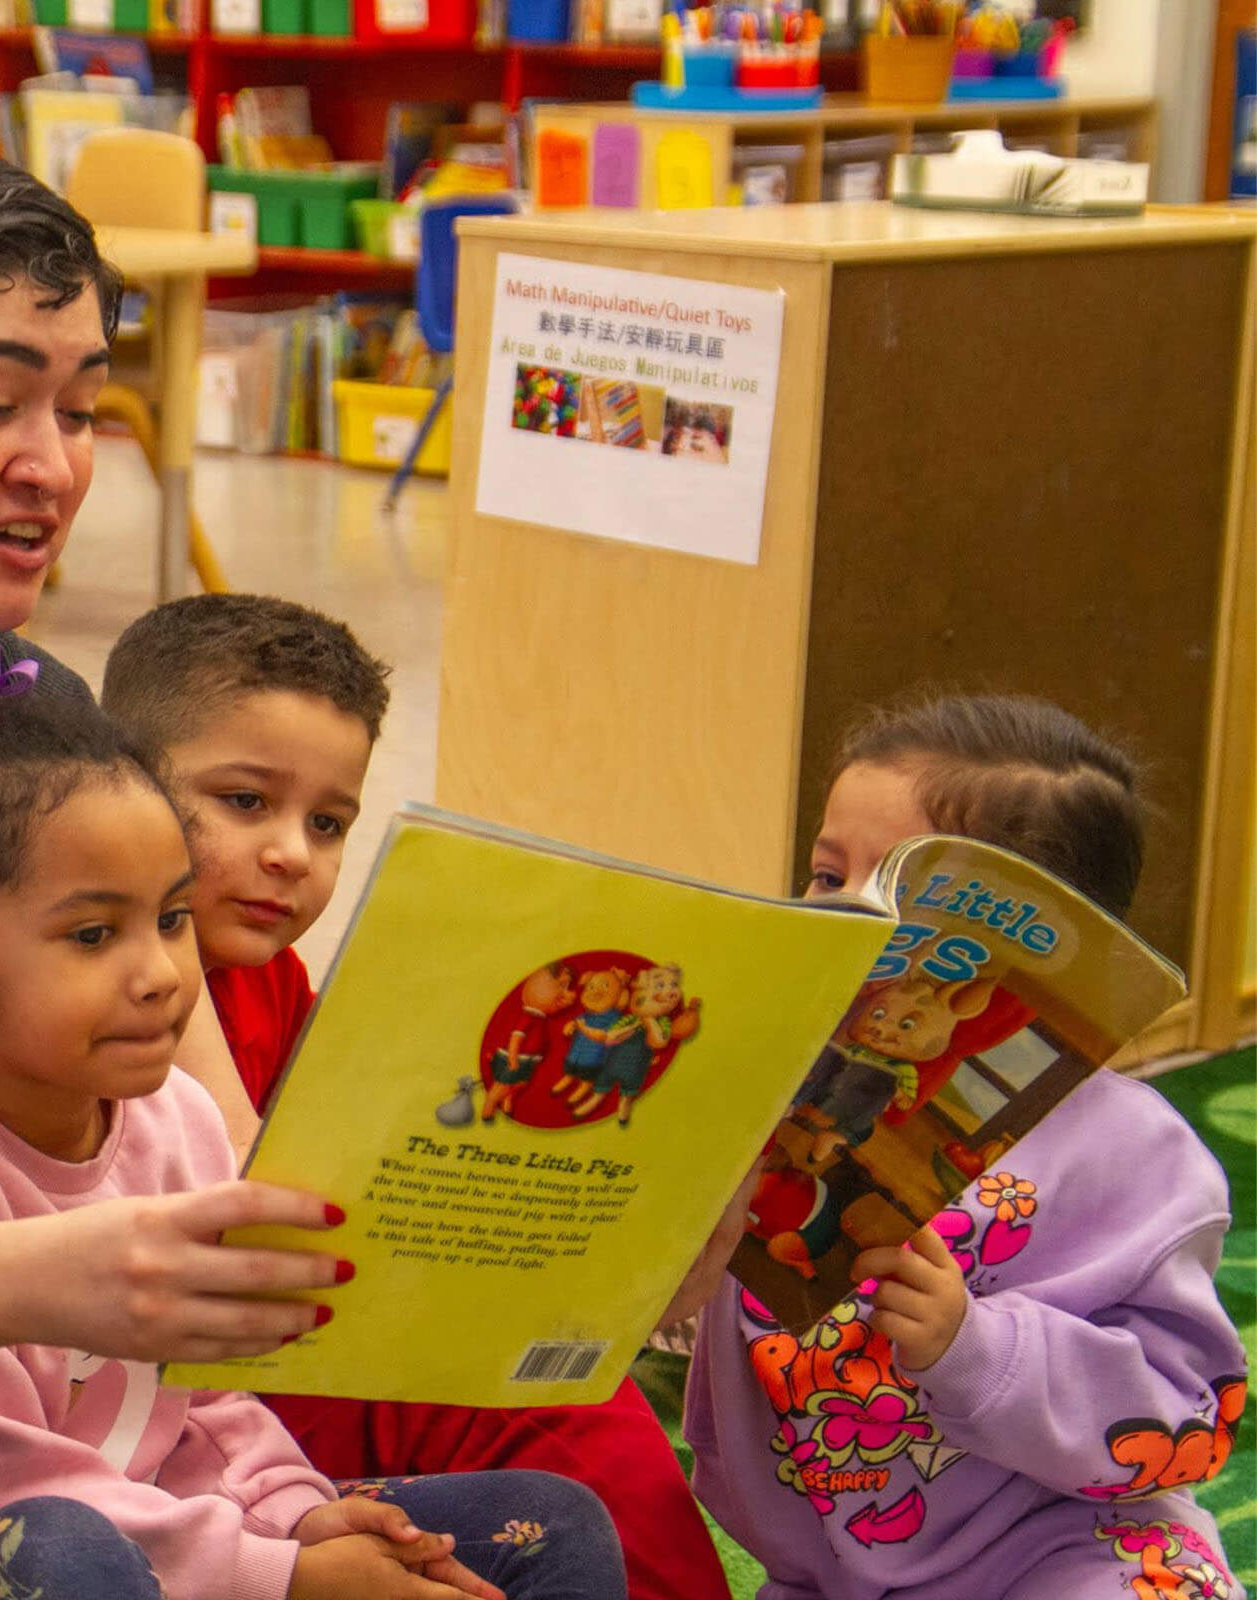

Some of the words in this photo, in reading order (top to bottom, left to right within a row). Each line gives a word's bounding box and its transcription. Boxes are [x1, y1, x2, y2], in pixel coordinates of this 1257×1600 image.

[506, 279, 546, 300] Math
[552, 285, 710, 326] Manipulative/Quiet
[717, 309, 752, 332] Toys
[543, 343, 563, 361] de
[571, 346, 627, 372] Juegos
[635, 357, 759, 393] Manipulativos
[914, 874, 1057, 953] Little
[408, 1136, 450, 1157] The
[456, 1143, 521, 1166] Three
[525, 1152, 583, 1173] Little
[586, 1159, 635, 1180] Pigs
[373, 1175, 393, 1186] the
[399, 1179, 431, 1194] tasty
[436, 1185, 470, 1196] meal
[473, 1187, 487, 1198] he
[492, 1191, 505, 1200] so
[510, 1192, 580, 1209] desperately
[381, 1159, 415, 1173] What
[421, 1167, 461, 1179] comes
[467, 1171, 519, 1186] between
[536, 1179, 582, 1194] hungry
[586, 1181, 611, 1193] wolf
[614, 1184, 638, 1194] and
[365, 1190, 375, 1201] A
[380, 1193, 416, 1206] clever
[422, 1199, 448, 1209] and
[451, 1203, 522, 1218] resourceful
[523, 1210, 545, 1223] pig
[549, 1212, 575, 1222] with
[366, 1229, 379, 1239] in
[384, 1231, 407, 1242] this
[412, 1235, 435, 1245] tale
[440, 1237, 454, 1247] of
[562, 1247, 588, 1256] and
[378, 1214, 409, 1227] Find
[412, 1219, 433, 1229] out
[438, 1221, 463, 1232] how
[469, 1223, 489, 1234] the
[492, 1226, 524, 1239] felon
[527, 1231, 552, 1241] gets
[557, 1231, 592, 1242] foiled
[392, 1248, 440, 1262] putting
[444, 1254, 461, 1265] up
[477, 1256, 511, 1268] good
[800, 1468, 829, 1489] BE
[828, 1467, 891, 1492] HAPPY
